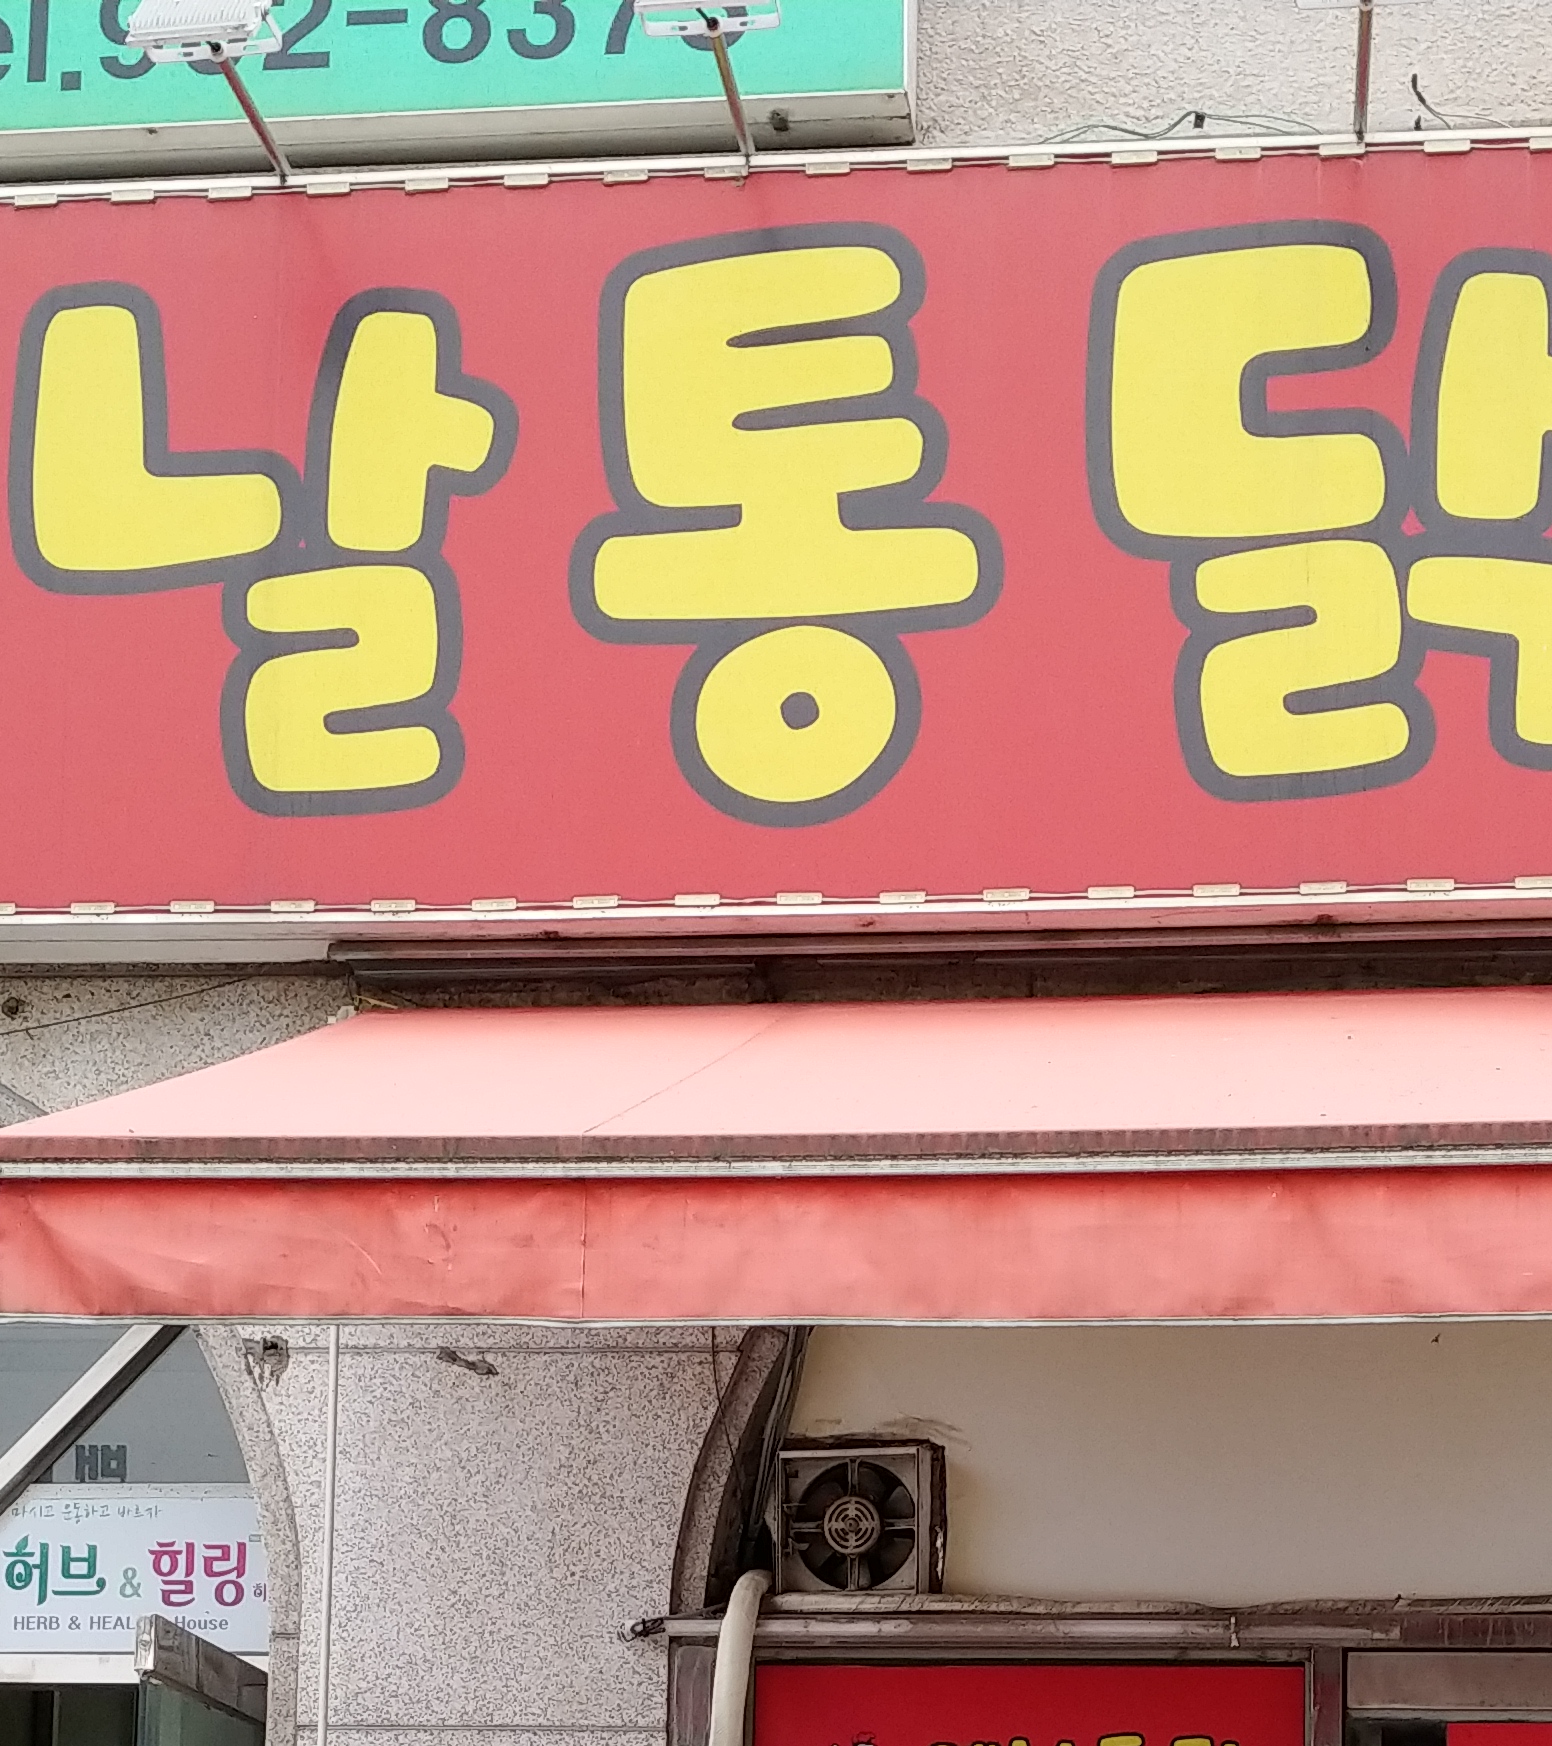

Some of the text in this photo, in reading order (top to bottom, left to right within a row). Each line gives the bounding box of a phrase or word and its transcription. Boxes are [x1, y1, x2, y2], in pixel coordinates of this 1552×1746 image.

[2, 1534, 106, 1606] 허브
[119, 1567, 142, 1598] &
[148, 1540, 247, 1607] 힐링
[13, 1616, 229, 1631] HERB & HEAL House
